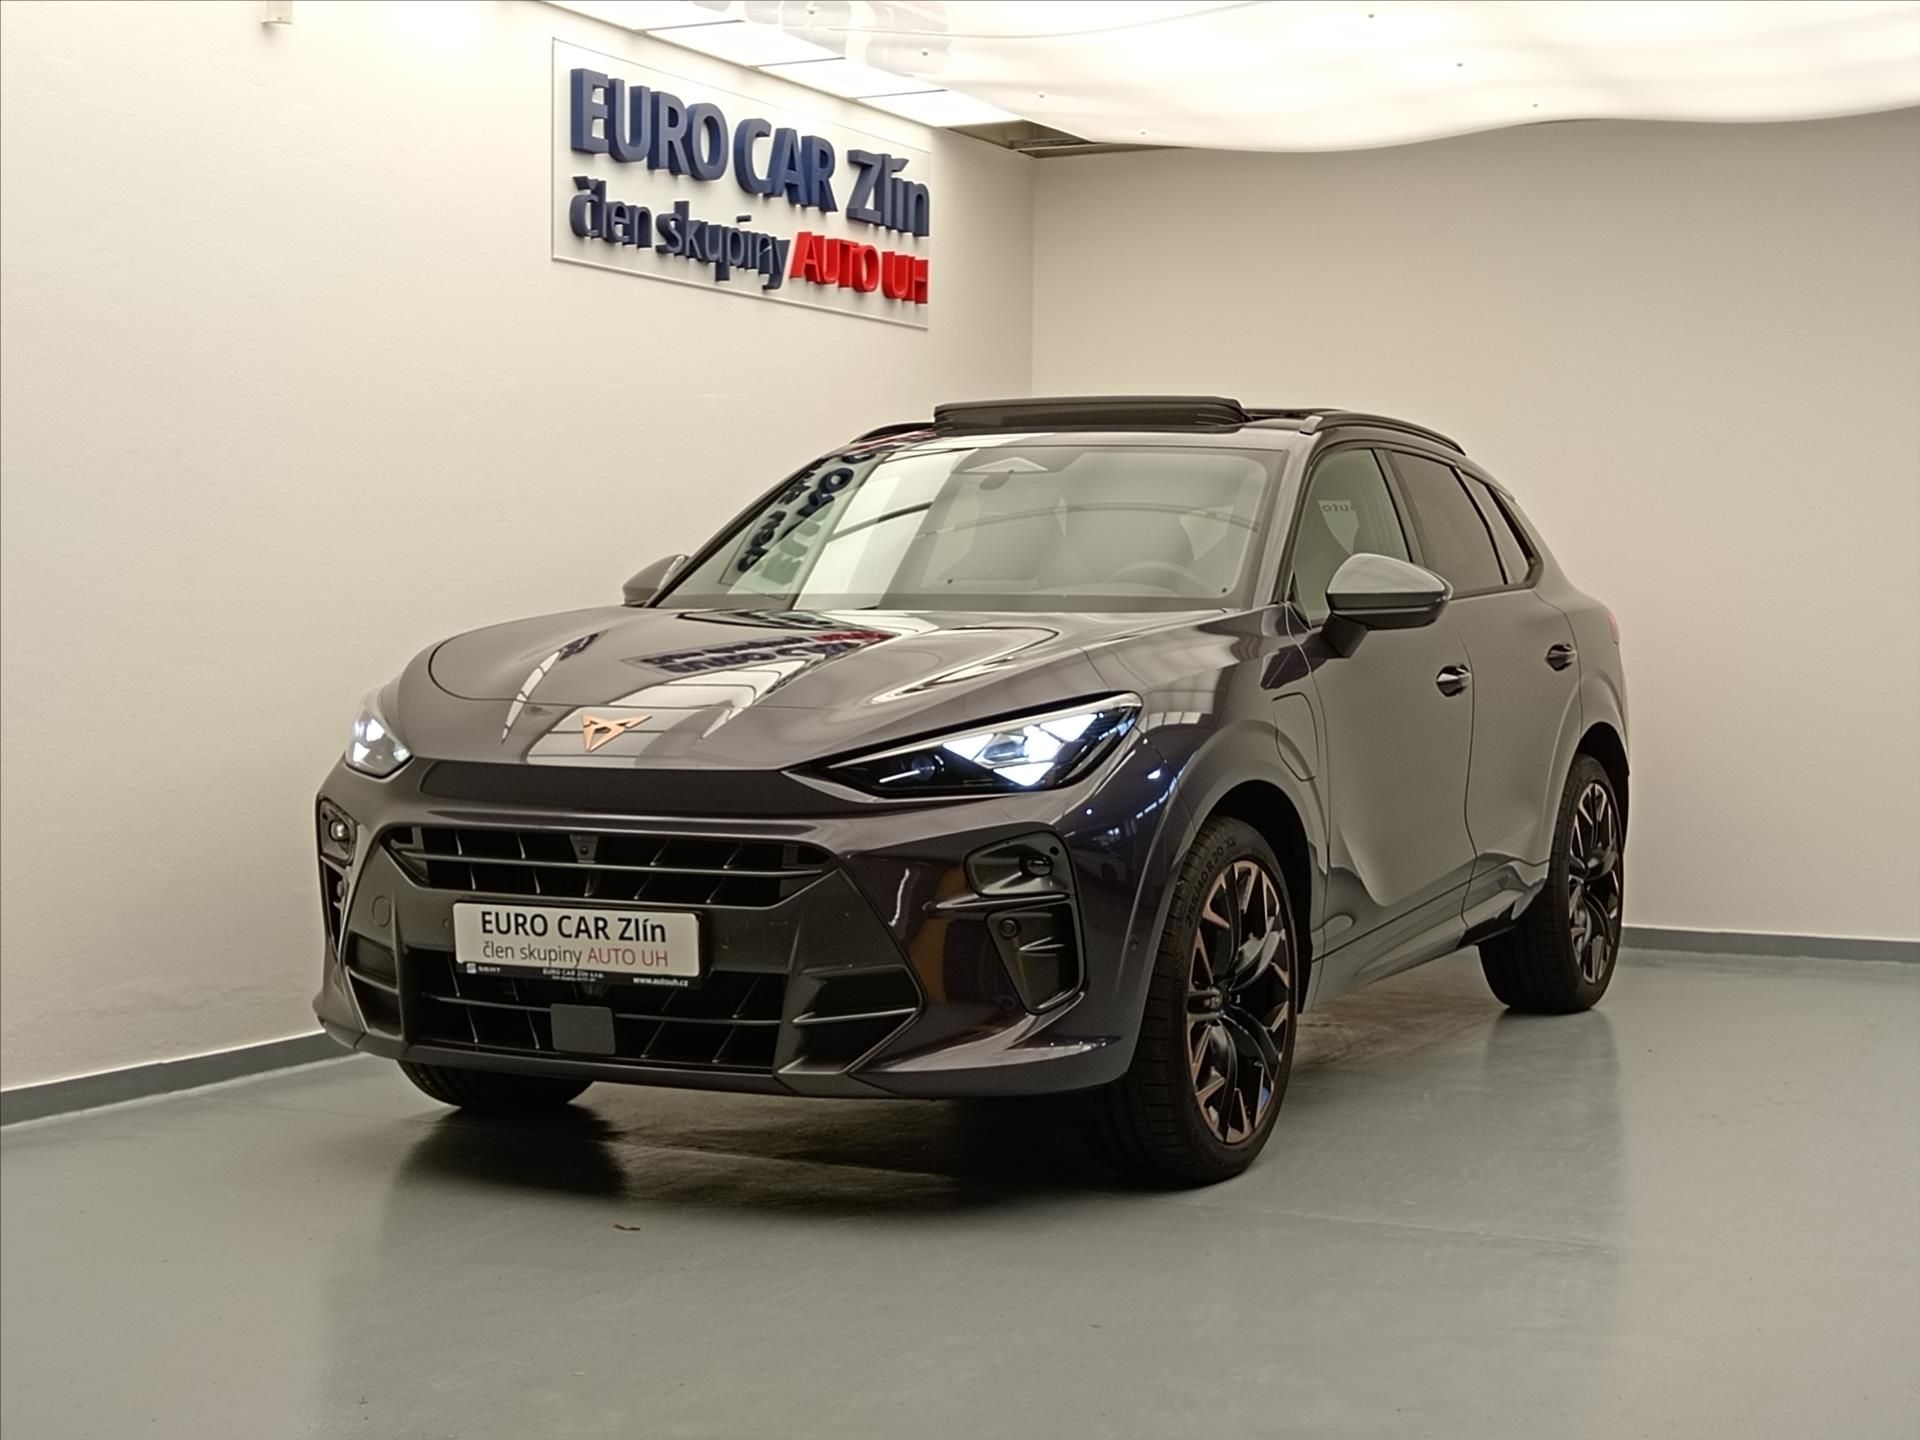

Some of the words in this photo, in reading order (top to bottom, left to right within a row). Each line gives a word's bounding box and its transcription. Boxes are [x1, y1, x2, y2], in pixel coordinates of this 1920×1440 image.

[570, 68, 729, 181] EURO
[733, 118, 838, 213] CAR
[845, 149, 930, 237] Zlín
[569, 175, 653, 249] člen
[655, 200, 791, 290] skupiny
[789, 231, 880, 293] AUTO
[881, 251, 929, 304] UH
[481, 910, 548, 937] EURO
[557, 914, 611, 941] CAR
[617, 917, 667, 943] Zlín
[483, 941, 515, 960] člen
[519, 943, 582, 967] skupiny
[587, 947, 636, 966] AUTO
[641, 950, 669, 967] UH
